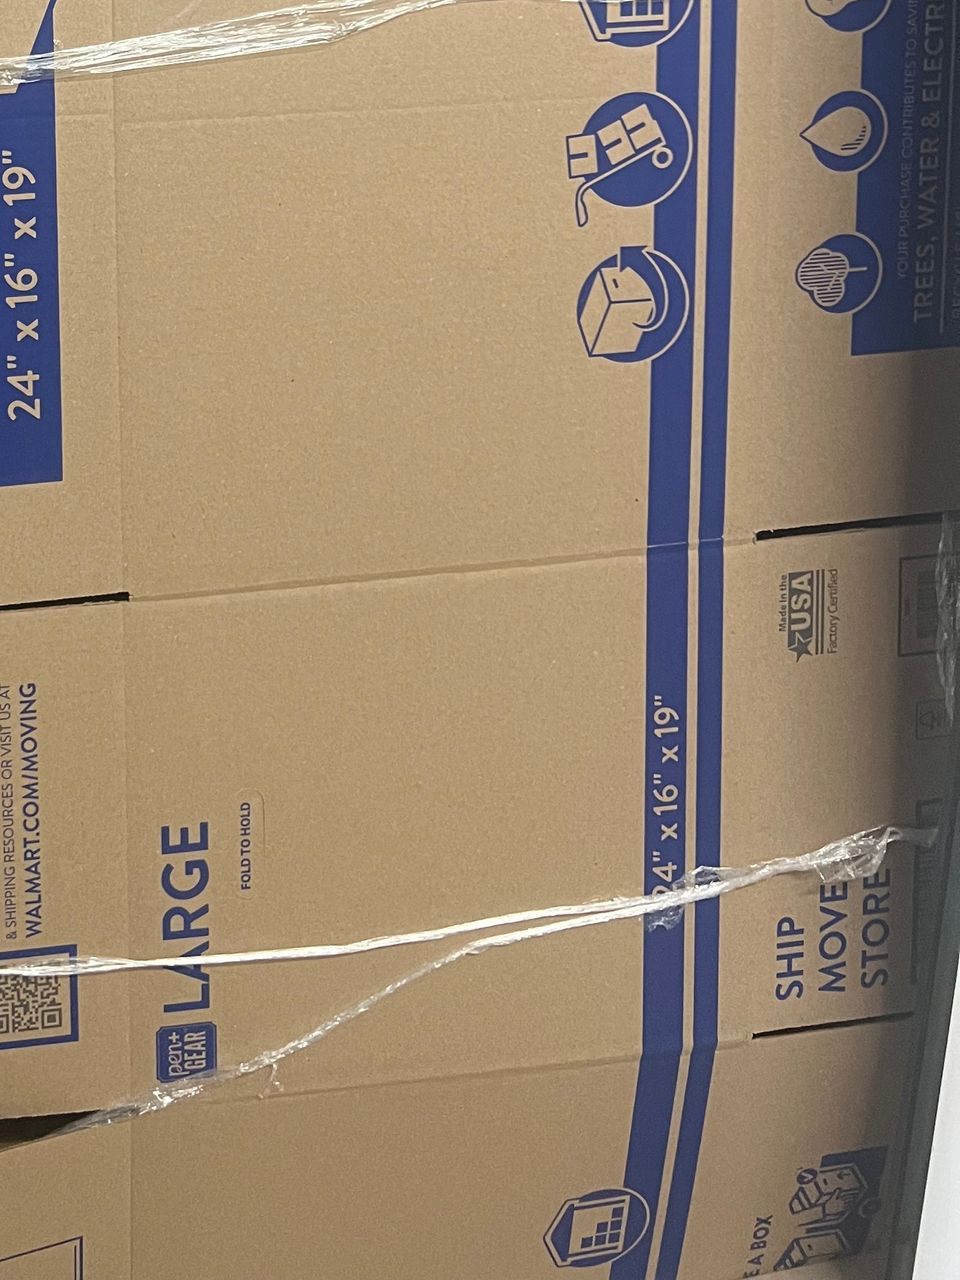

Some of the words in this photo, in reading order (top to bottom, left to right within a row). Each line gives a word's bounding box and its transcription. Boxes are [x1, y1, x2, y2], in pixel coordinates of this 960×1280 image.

[905, 38, 917, 57] TO
[901, 61, 916, 161] CONTRIBUTES
[921, 111, 940, 128] &
[1, 150, 36, 206] 19"
[916, 137, 940, 231] WATER
[898, 164, 912, 237] PURCHASE
[14, 216, 37, 239] x
[3, 253, 38, 309] 16"
[896, 241, 909, 280] YOUR
[913, 236, 938, 323] TREES,
[16, 319, 39, 341] x
[6, 355, 40, 420] 24"
[779, 575, 787, 592] the
[791, 572, 812, 631] USA
[827, 568, 838, 613] Certified
[778, 605, 787, 632] Made
[827, 615, 840, 654] Factory
[0, 702, 11, 721] US
[653, 695, 680, 738] 19"
[0, 724, 12, 757] VISIT
[662, 744, 679, 763] x
[1, 759, 12, 780] OR
[19, 682, 43, 938] WALMART.COM/MOVING
[653, 773, 679, 816] 16"
[1, 783, 16, 862] RESOURCES
[240, 802, 251, 836] HOLD
[661, 823, 678, 841] x
[241, 838, 251, 855] TO
[241, 858, 251, 890] FOLD
[4, 866, 17, 928] SHIPPING
[161, 821, 210, 1013] LARGE
[6, 930, 17, 940] &
[818, 881, 847, 992] MOVE
[861, 868, 890, 989] STORE
[775, 916, 804, 1000] SHIP
[184, 1031, 207, 1075] GEAR
[750, 1215, 773, 1250] BOX
